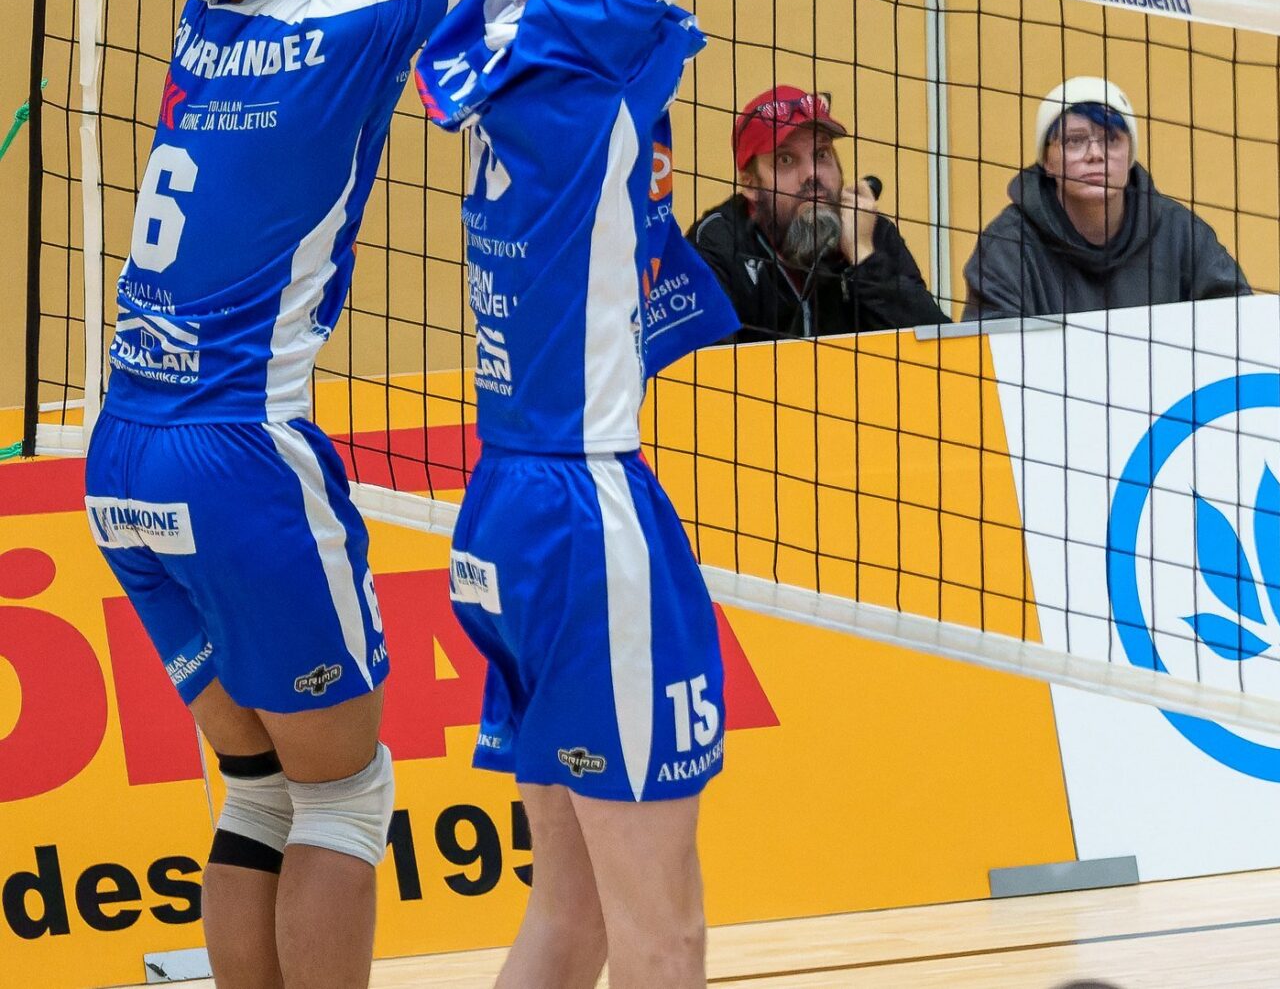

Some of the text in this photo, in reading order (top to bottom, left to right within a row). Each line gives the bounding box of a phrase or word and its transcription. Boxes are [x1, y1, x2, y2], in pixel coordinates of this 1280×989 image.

[179, 110, 278, 131] KONE JA KULJETUS
[130, 142, 199, 274] 6
[669, 291, 697, 311] Oy
[665, 673, 720, 753] 15
